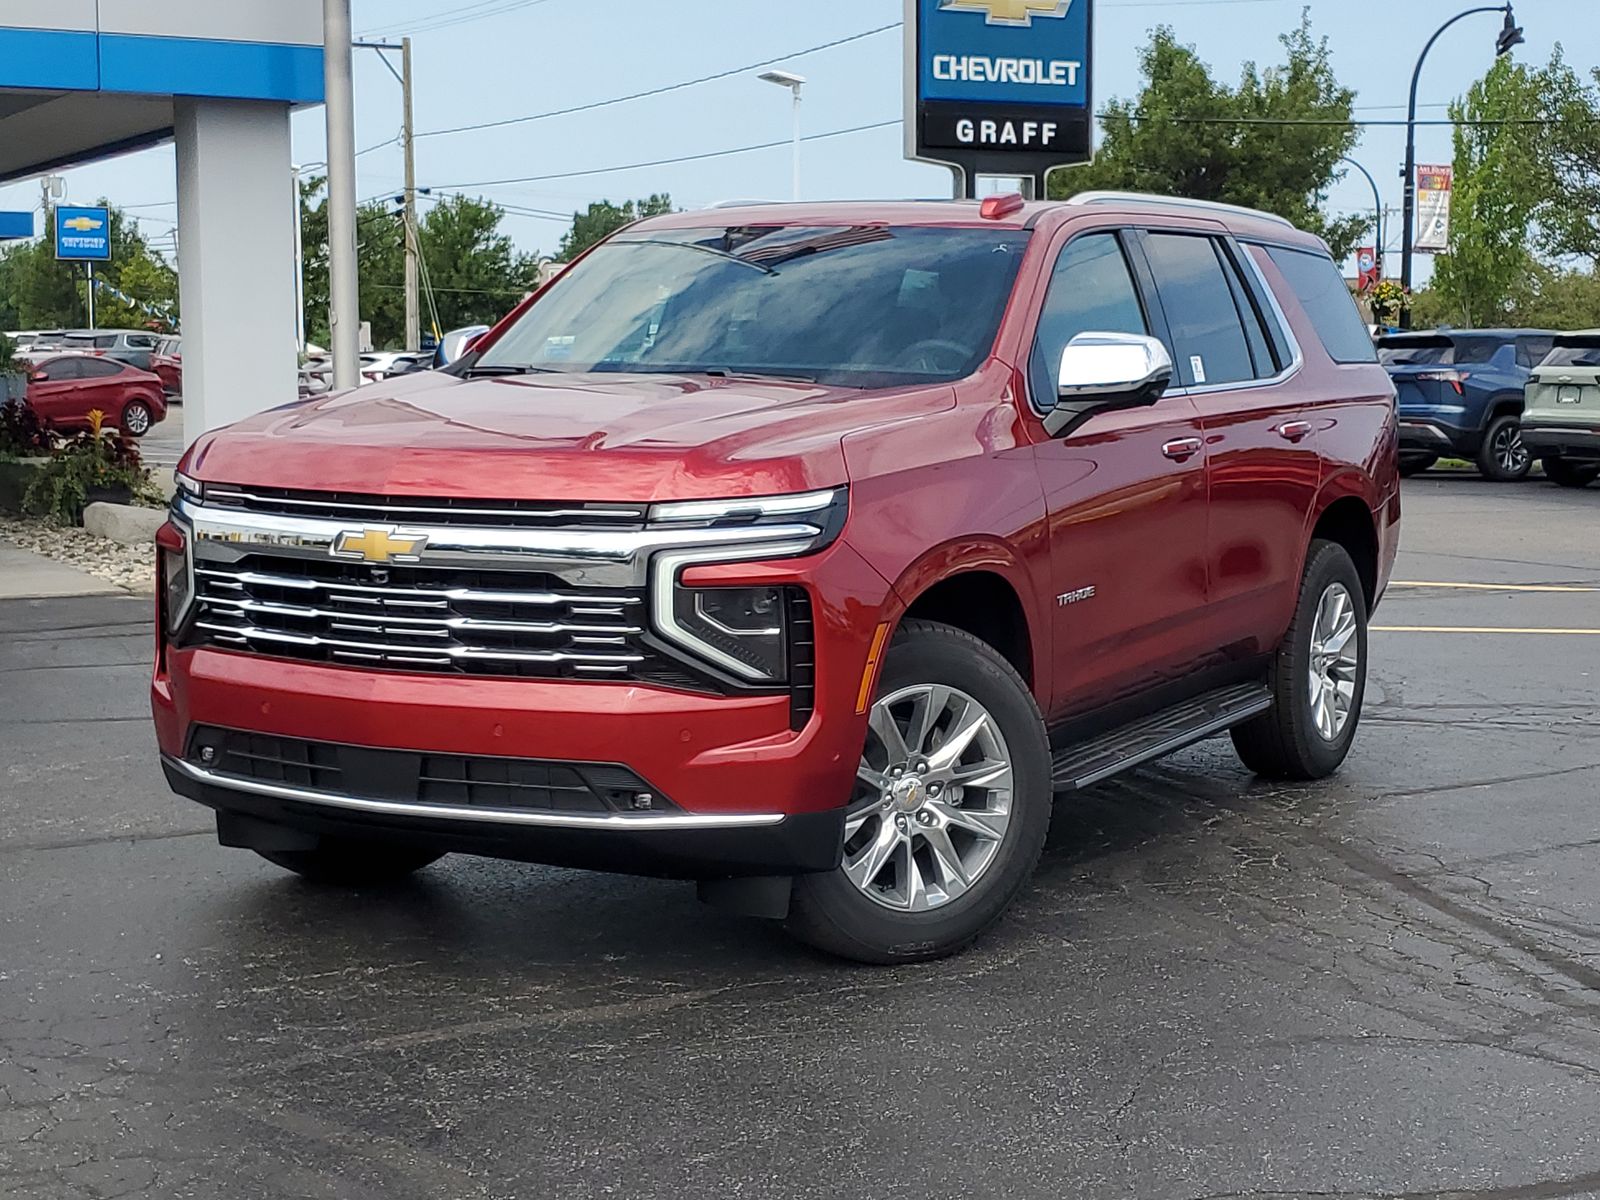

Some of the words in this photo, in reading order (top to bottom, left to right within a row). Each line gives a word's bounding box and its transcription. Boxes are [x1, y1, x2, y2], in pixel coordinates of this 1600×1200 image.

[933, 55, 1081, 85] CHEVROLET
[956, 119, 1057, 145] GRAFF
[1057, 585, 1095, 606] TAHOE
